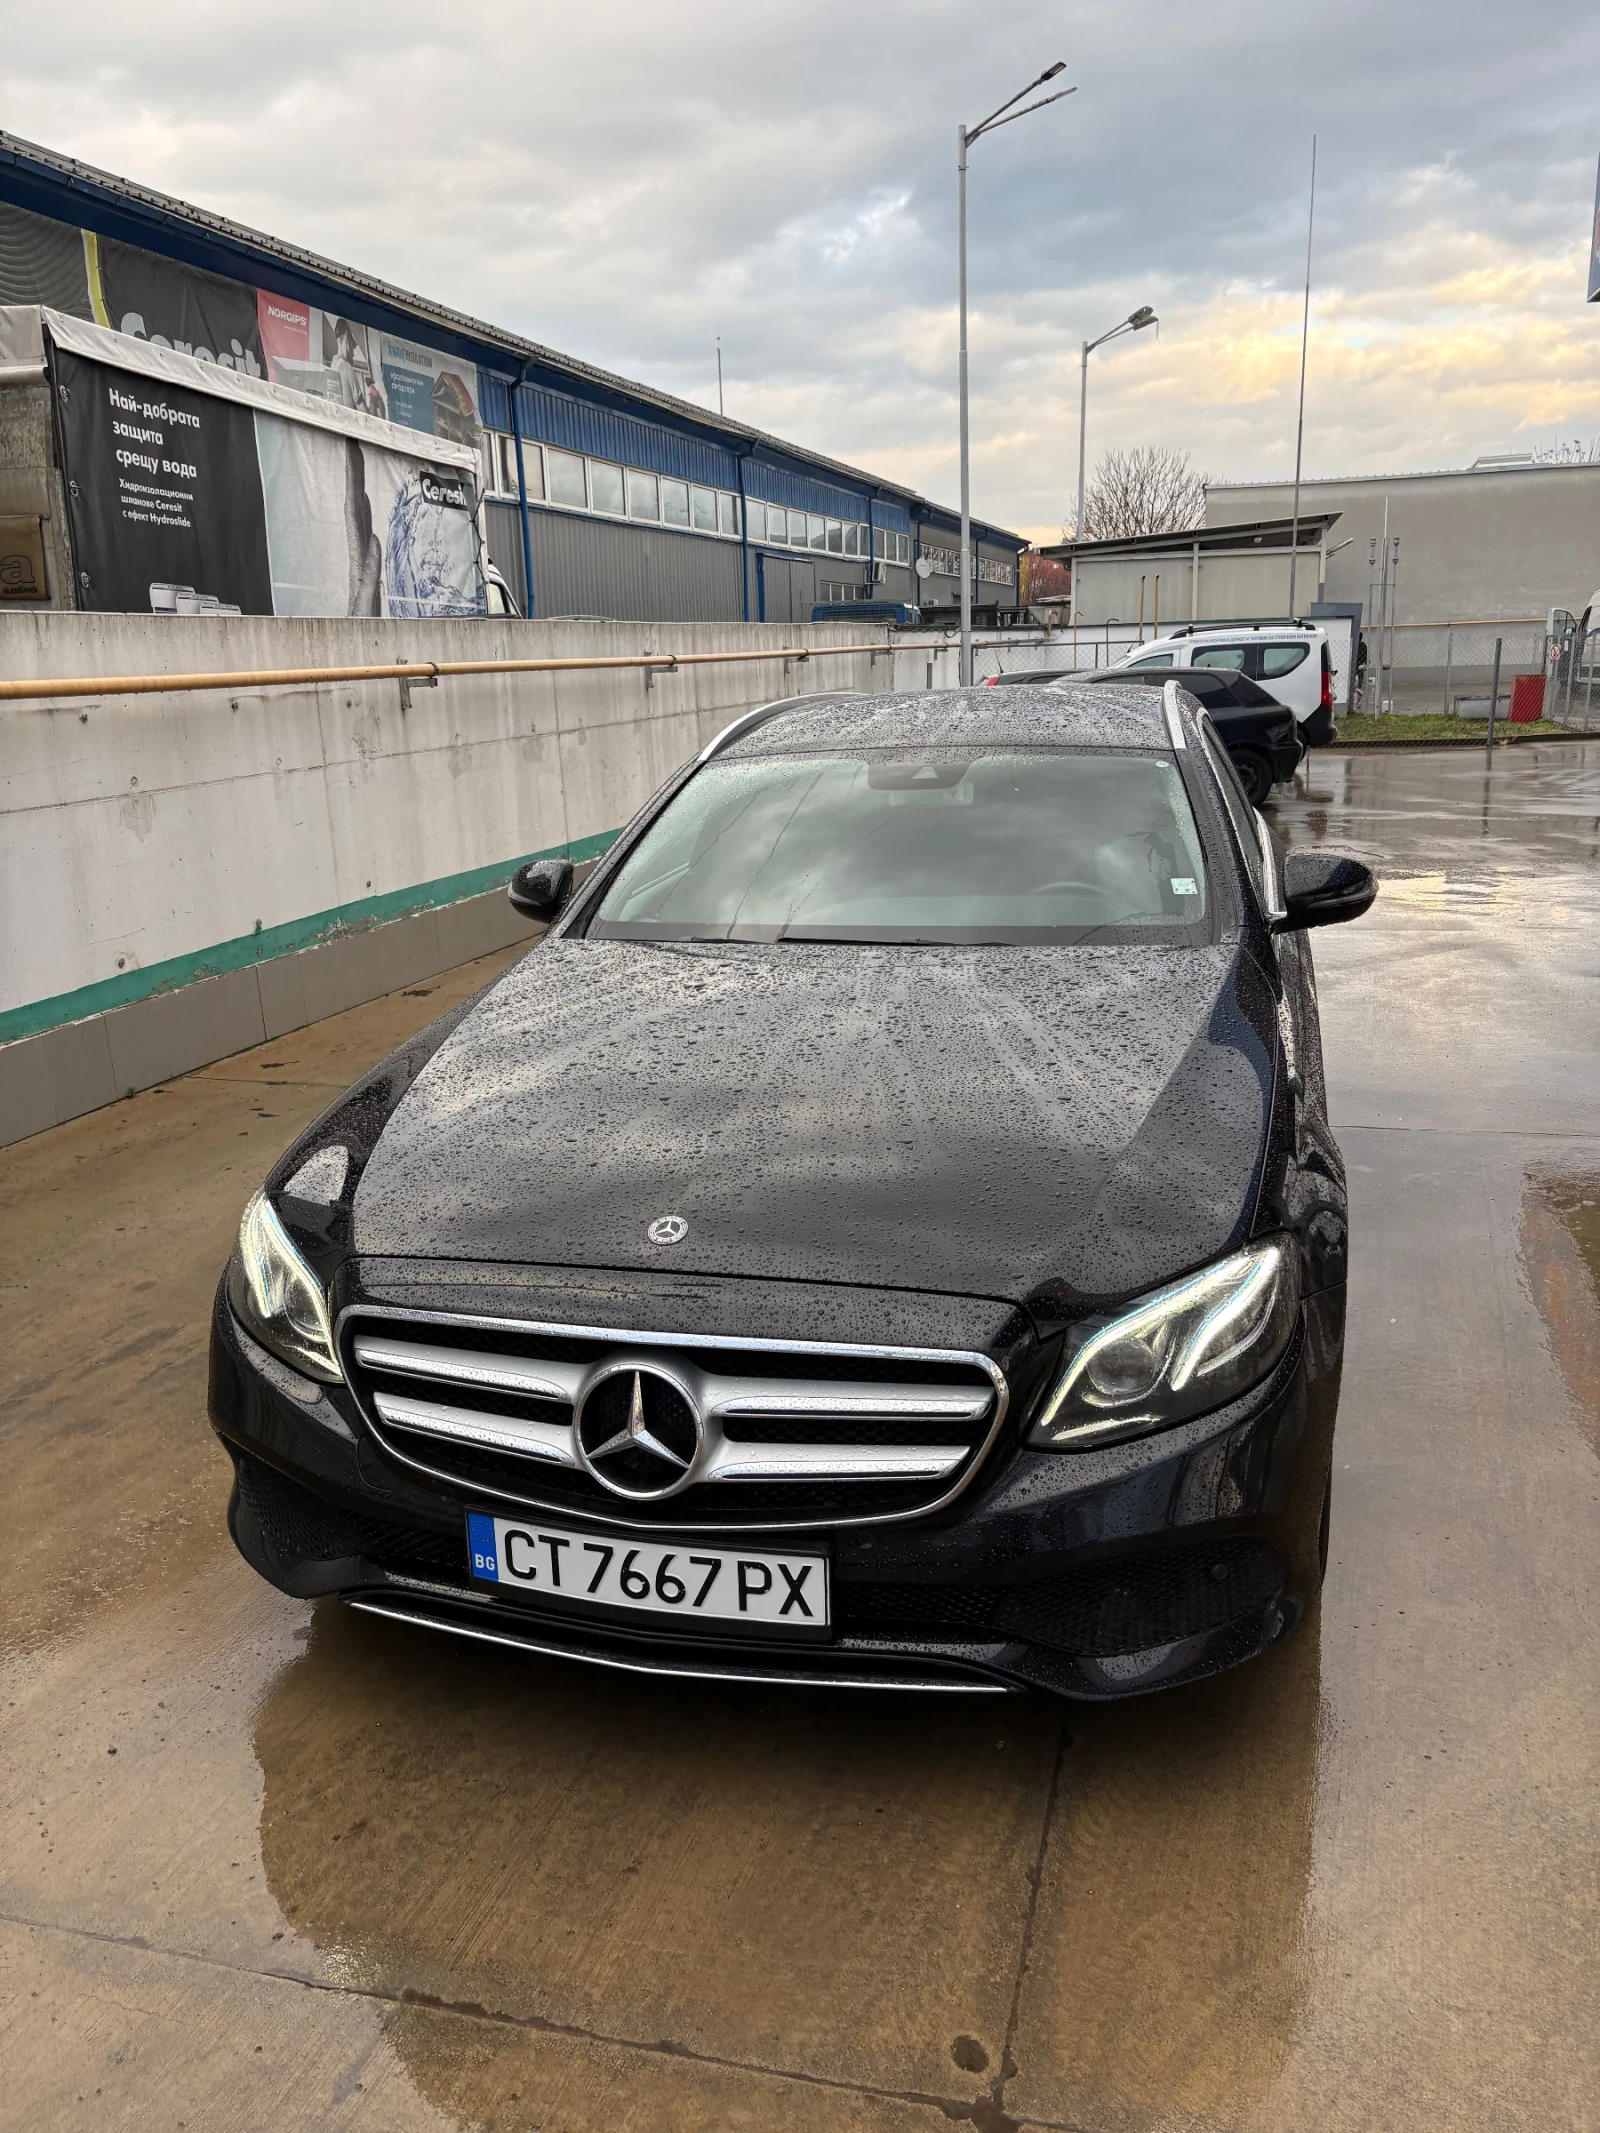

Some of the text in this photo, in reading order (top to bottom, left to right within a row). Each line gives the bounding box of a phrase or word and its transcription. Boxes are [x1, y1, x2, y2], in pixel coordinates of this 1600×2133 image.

[268, 305, 307, 326] NORGIPS
[108, 387, 200, 428] Най-добрата
[112, 420, 164, 445] защита
[115, 449, 197, 479] срещу вода
[119, 477, 193, 501] Хидроизолационни
[120, 495, 182, 512] шланове Ceresit
[127, 509, 149, 522] ефект
[149, 512, 191, 527] Hydroslide
[474, 1553, 495, 1571] BG
[504, 1529, 813, 1617] CT 7667 PX
